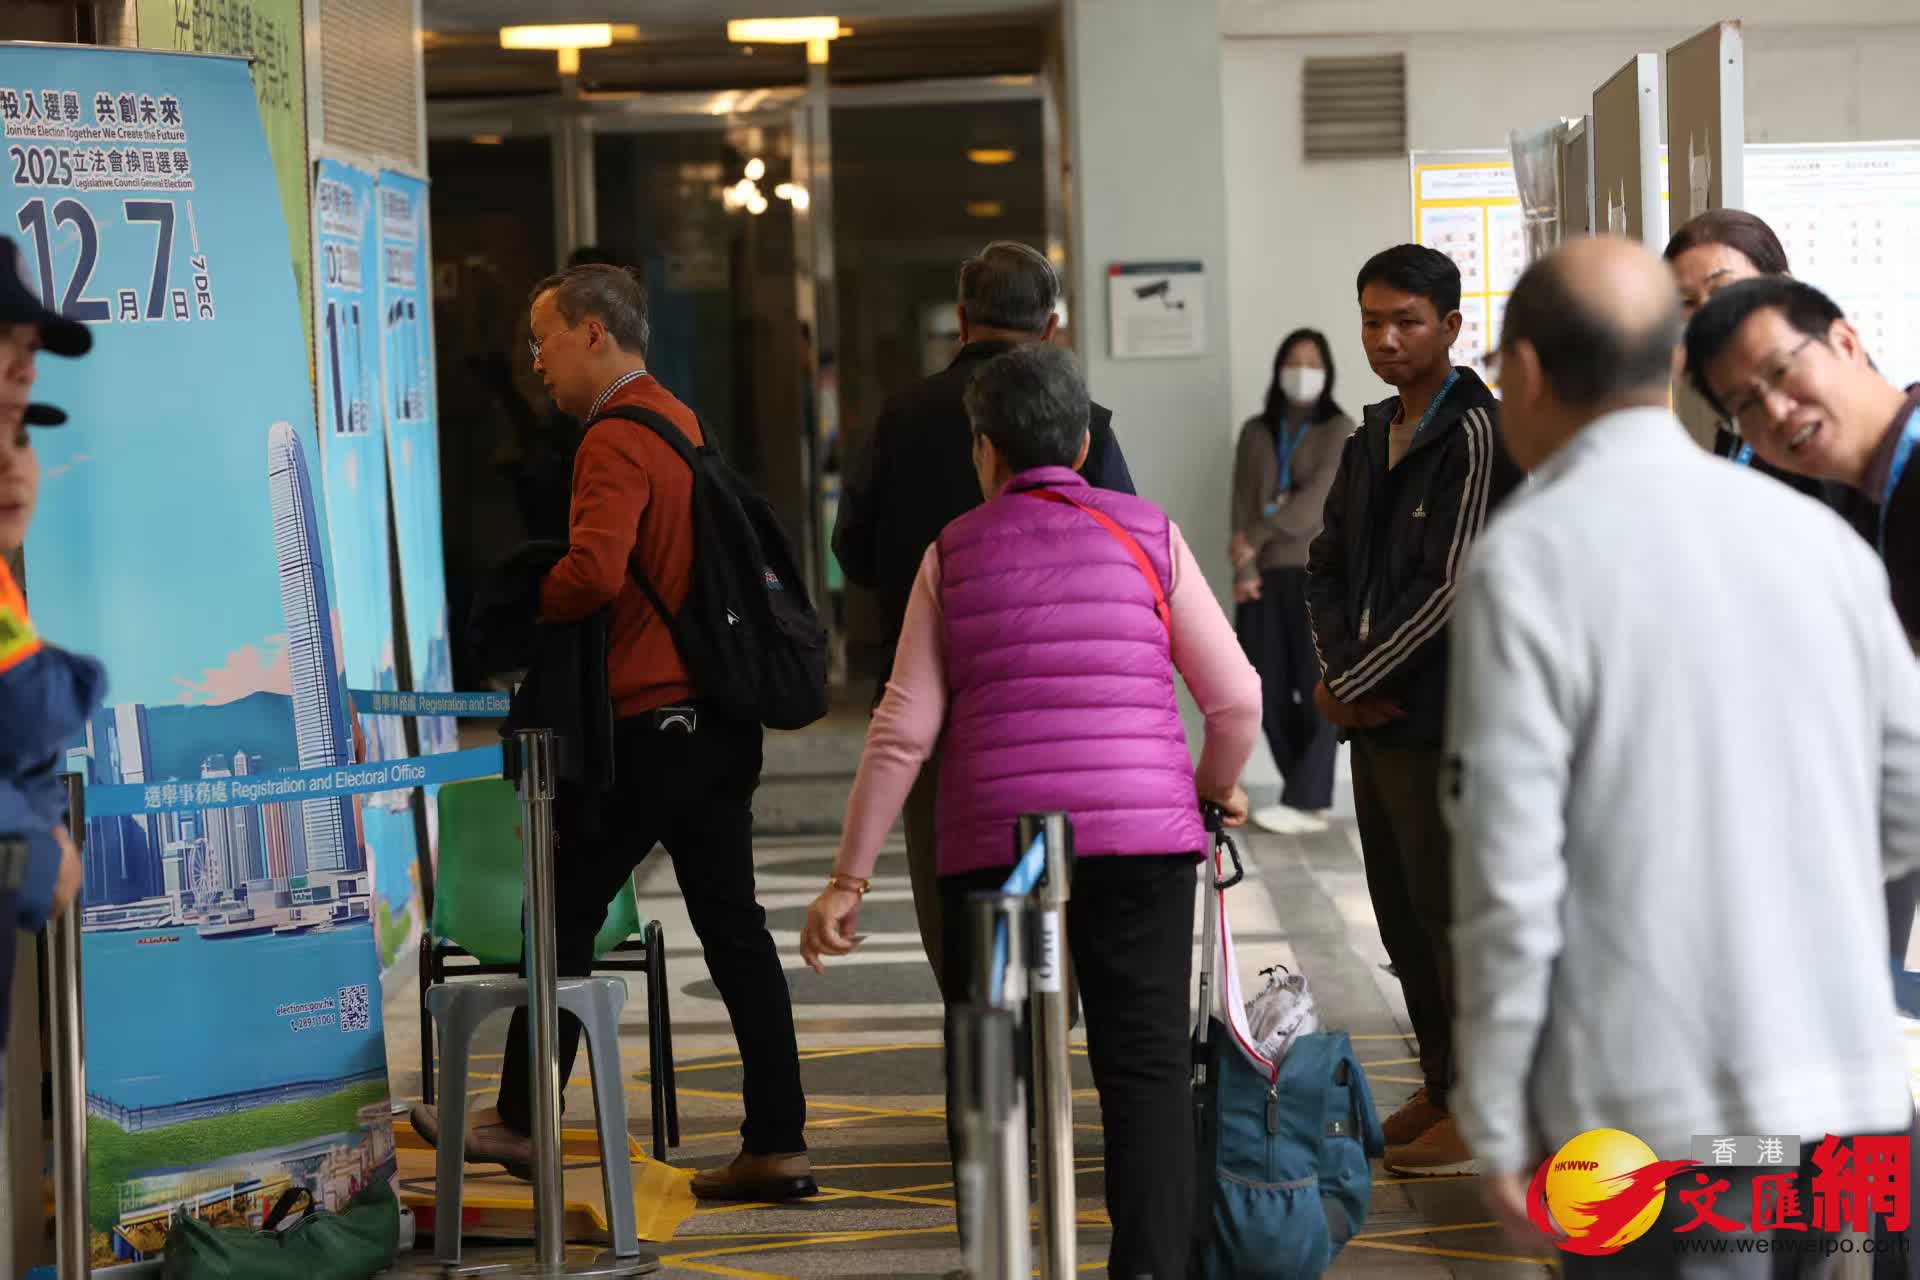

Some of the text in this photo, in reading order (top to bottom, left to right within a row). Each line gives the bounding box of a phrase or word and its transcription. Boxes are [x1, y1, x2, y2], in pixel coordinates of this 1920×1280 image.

[0, 91, 181, 125] 投入選舉 共創未來
[6, 124, 185, 141] Join the Election Together We Create the Future
[75, 178, 192, 190] Legislative Council General Election
[195, 276, 212, 318] DEC
[419, 695, 468, 713] Registration
[469, 696, 485, 711] and
[231, 777, 305, 801] Registration
[309, 772, 332, 791] and
[336, 767, 388, 789] Electoral
[391, 763, 426, 782] Office
[276, 999, 334, 1014] elections.gov.hk
